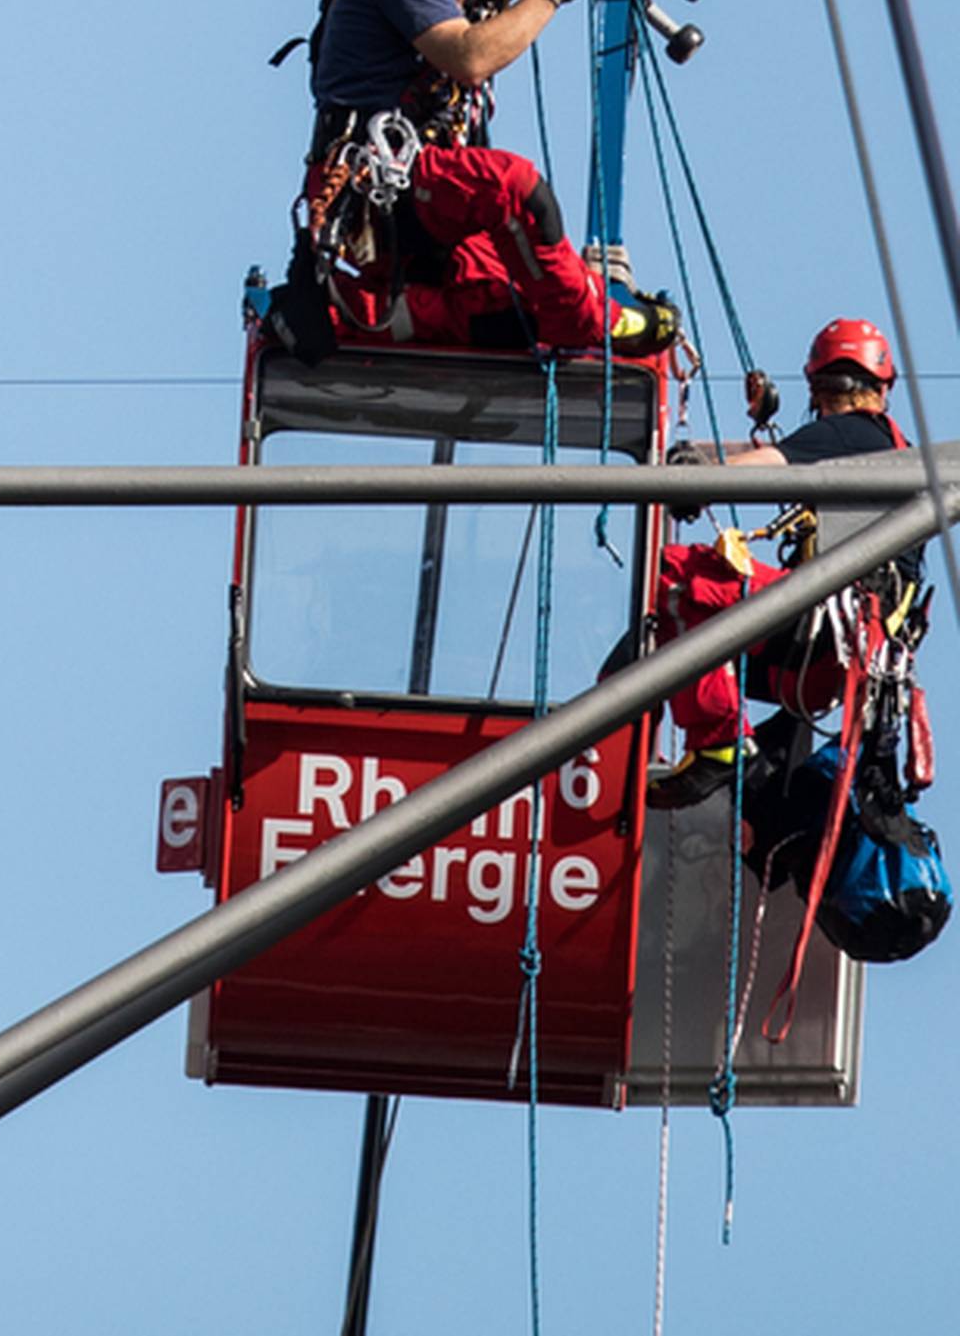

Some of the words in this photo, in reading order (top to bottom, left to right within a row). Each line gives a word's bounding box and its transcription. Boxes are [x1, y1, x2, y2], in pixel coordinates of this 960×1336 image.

[298, 753, 544, 841] Rhn
[559, 747, 600, 809] 6
[163, 785, 198, 847] e
[260, 819, 600, 924] Eergie
